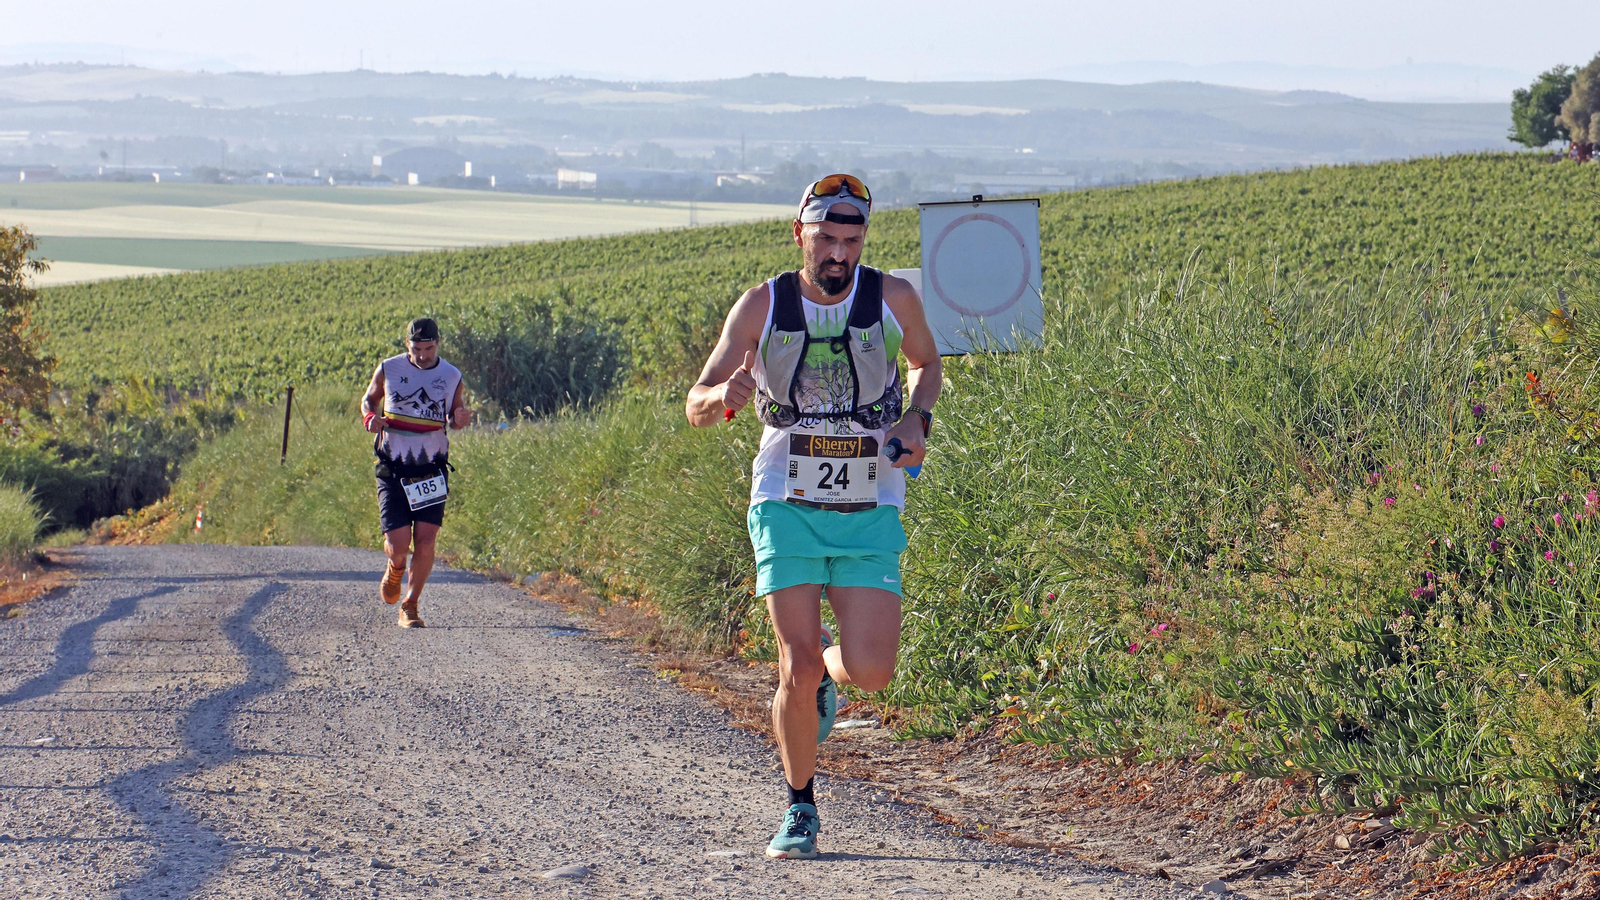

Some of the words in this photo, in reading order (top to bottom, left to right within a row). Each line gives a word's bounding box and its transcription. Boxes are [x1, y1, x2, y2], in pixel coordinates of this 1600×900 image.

[814, 436, 857, 455] Sherry
[817, 462, 850, 490] 24
[415, 480, 437, 496] 185
